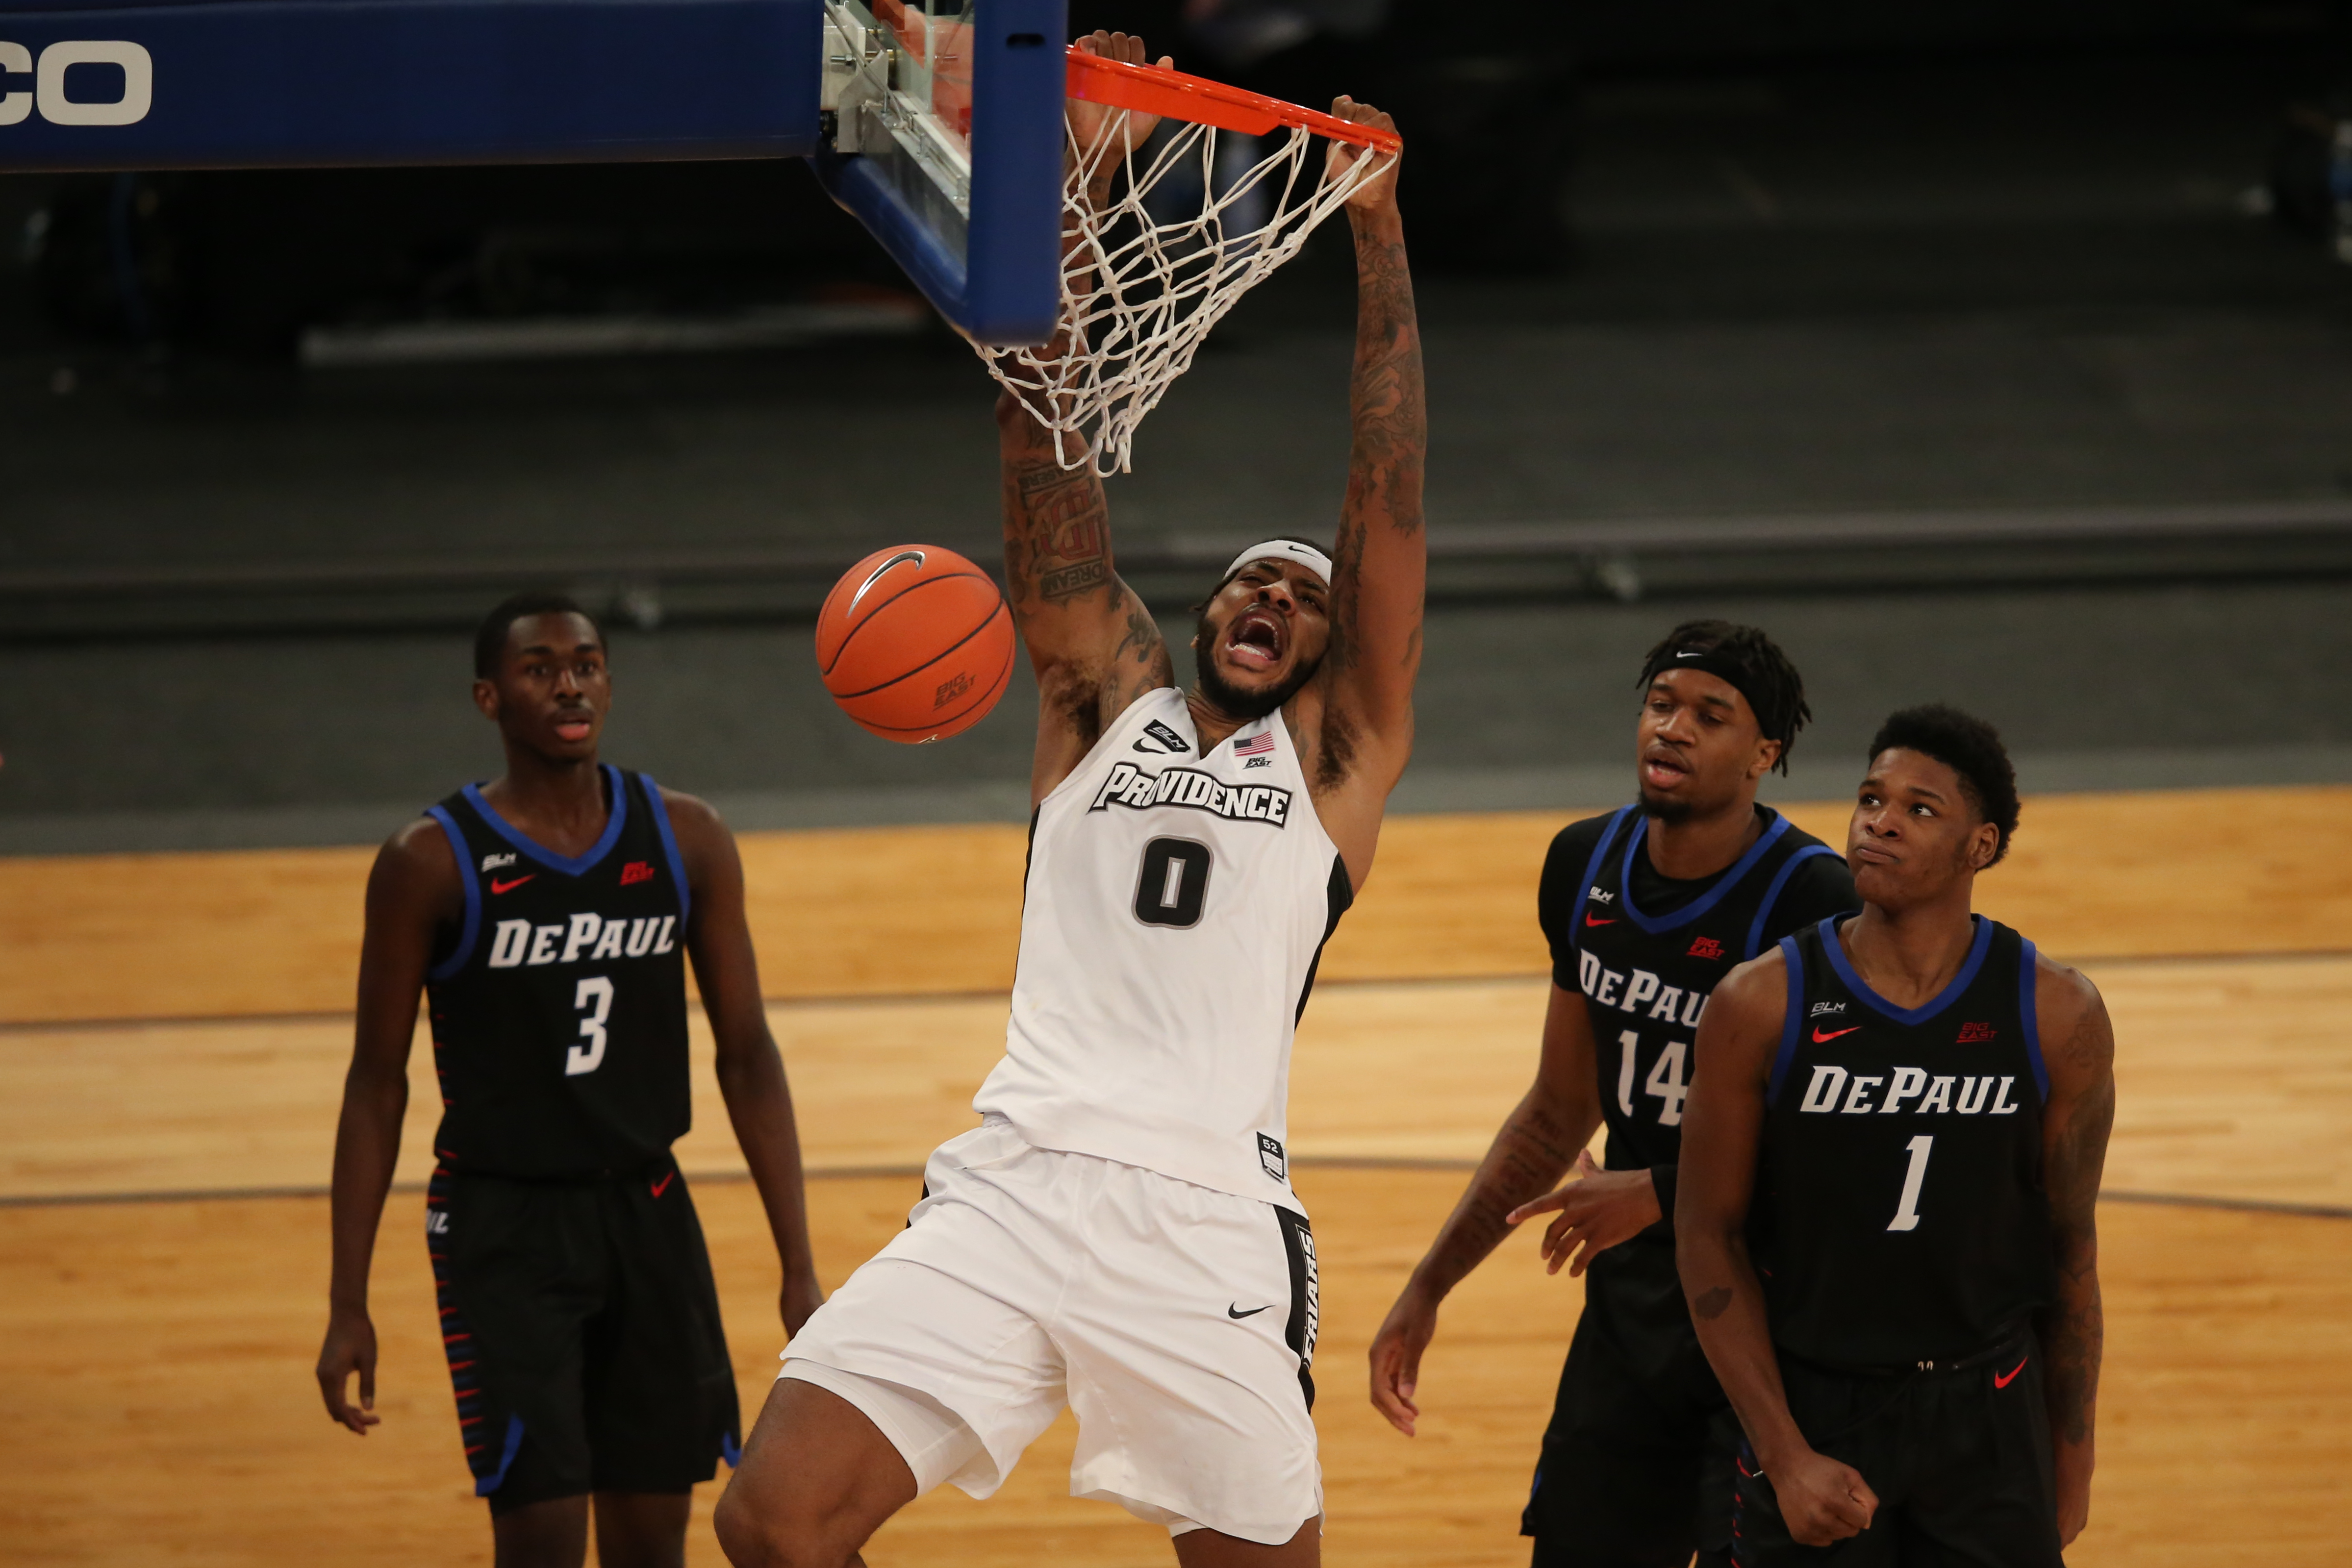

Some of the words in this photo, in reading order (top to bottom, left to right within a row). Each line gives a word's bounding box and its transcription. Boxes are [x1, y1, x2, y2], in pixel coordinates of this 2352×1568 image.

[0, 41, 152, 125] O
[1152, 726, 1186, 748] BLM
[1090, 763, 1292, 826] PROVIDENCE
[1131, 834, 1214, 930] 0
[1690, 944, 1725, 957] EAST
[1694, 936, 1720, 948] BIG
[565, 975, 614, 1077] 3
[1811, 1001, 1846, 1013] BLM
[1962, 1022, 1989, 1031] BIG
[1958, 1030, 1998, 1039] EAST
[1618, 1029, 1688, 1127] 14
[1262, 1138, 1279, 1154] 52
[1886, 1135, 1934, 1231] 1
[1299, 1230, 1318, 1365] FRIARS
